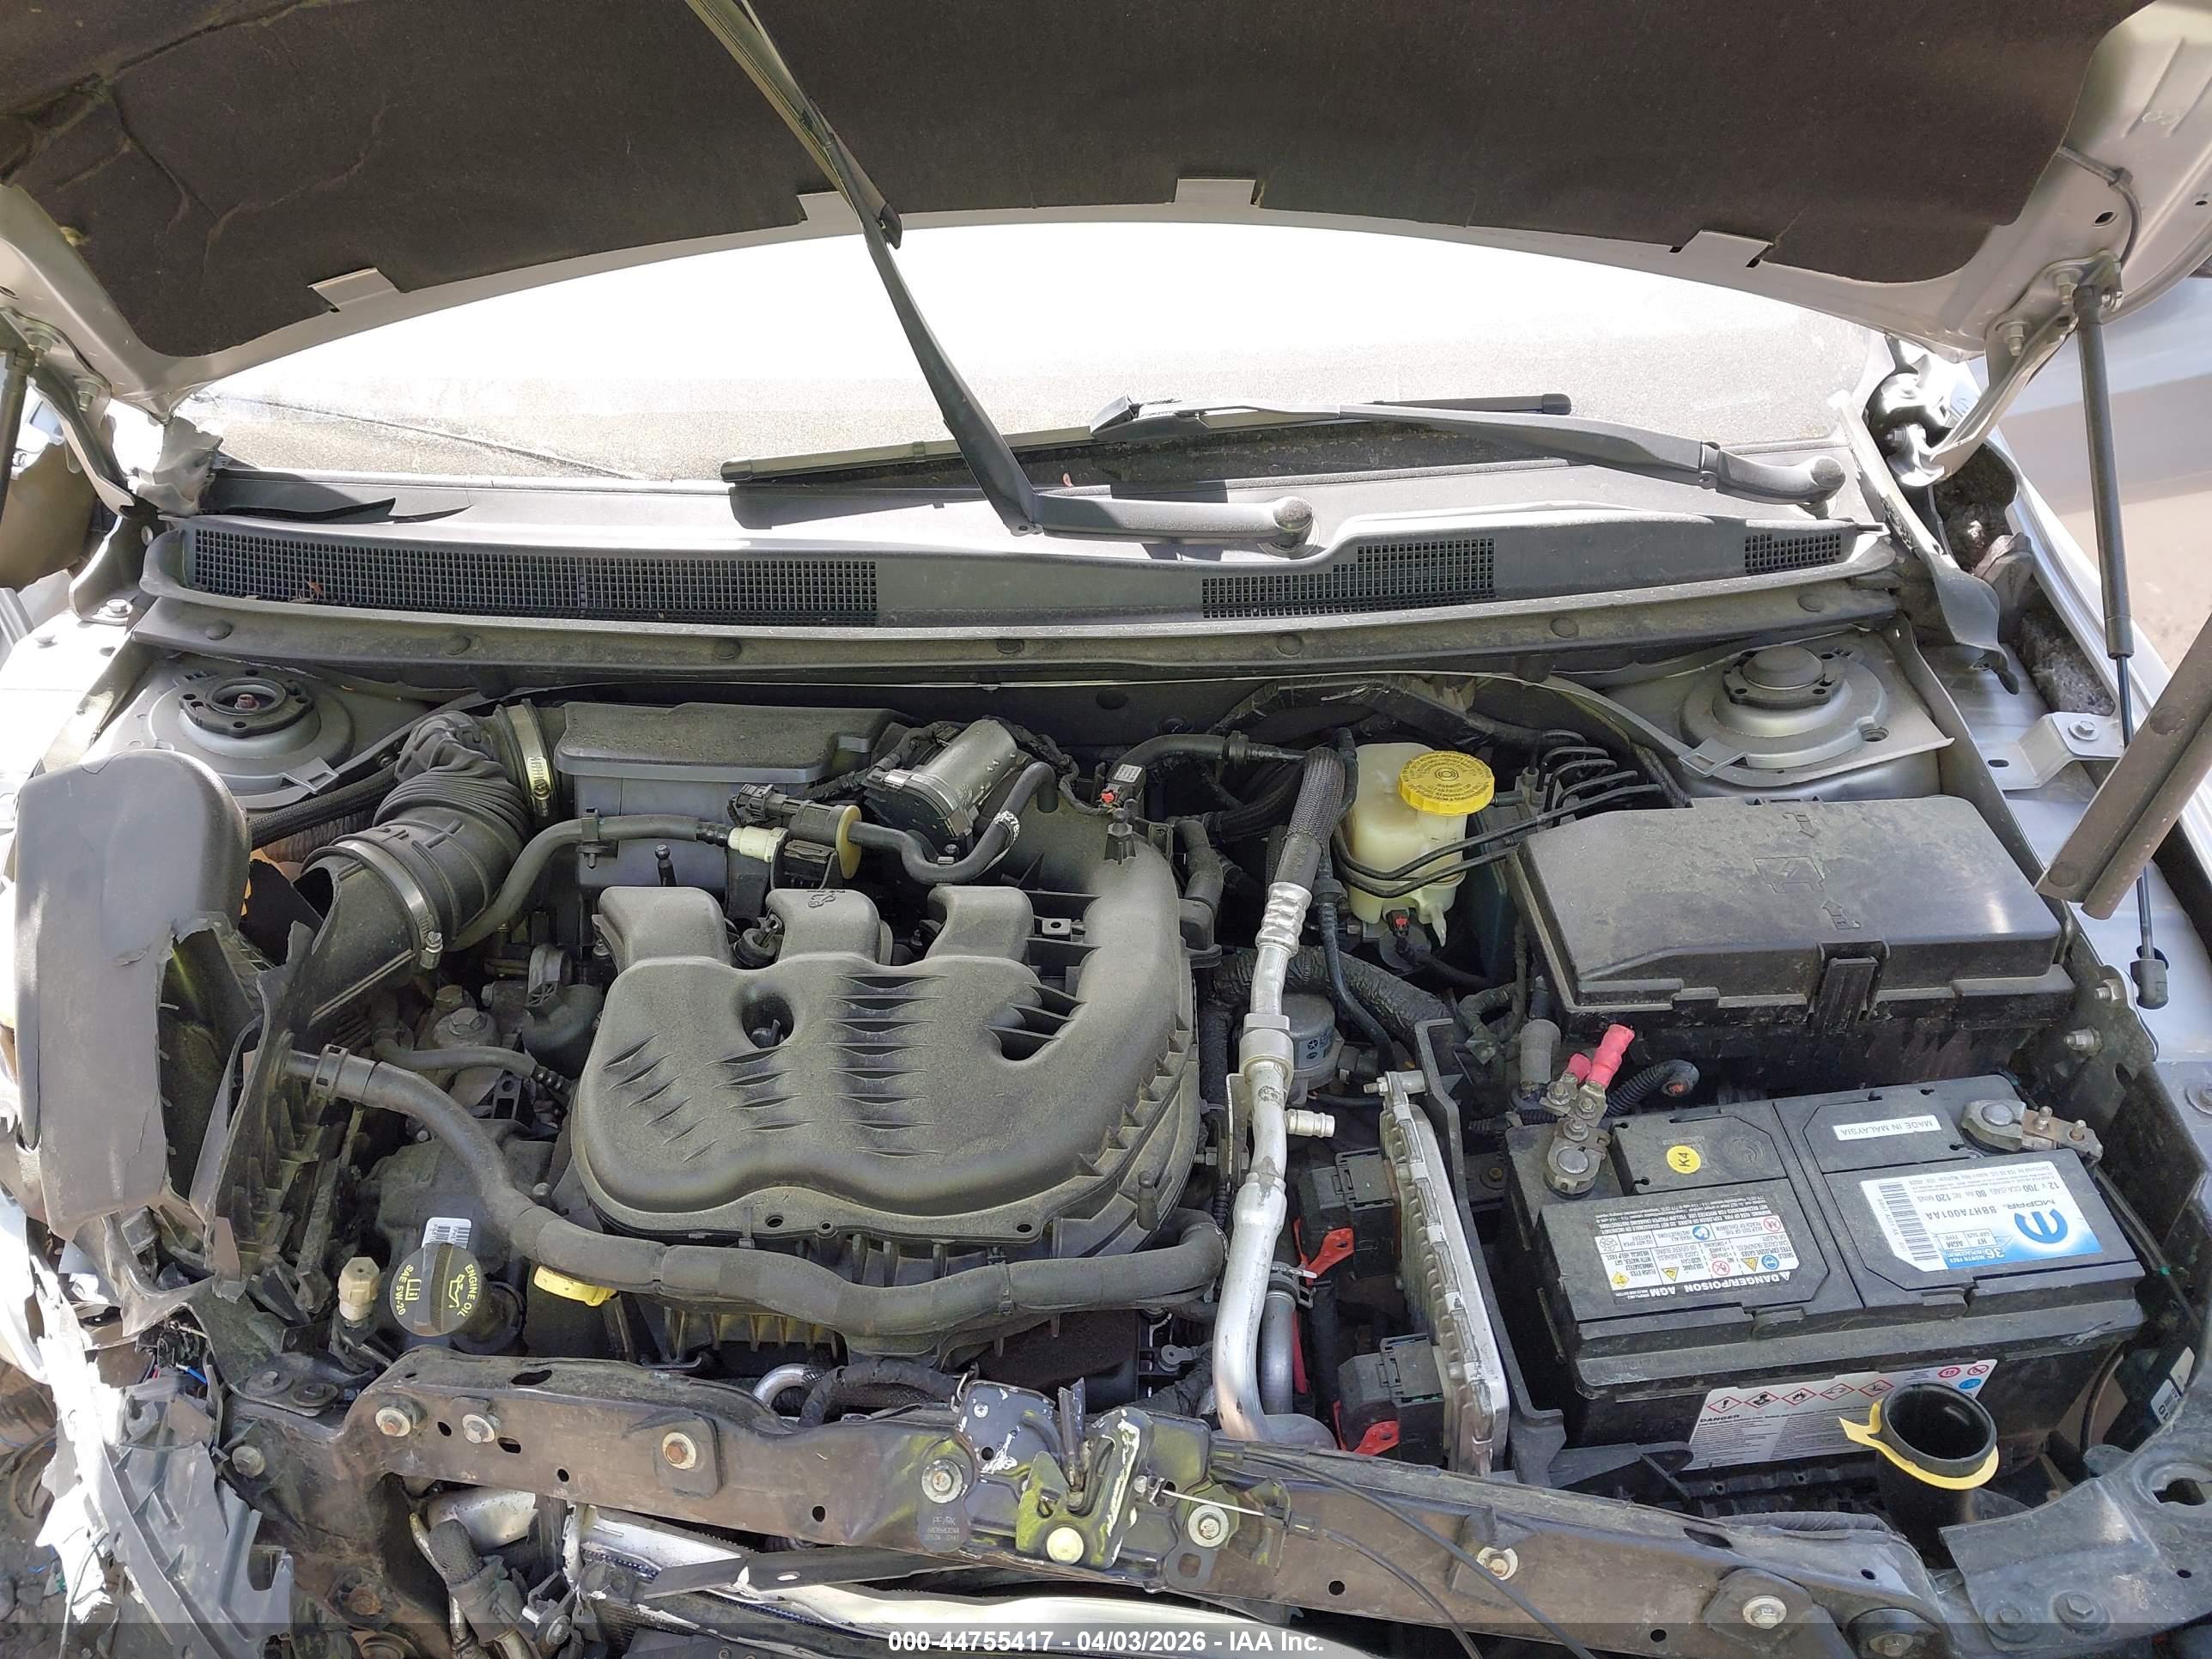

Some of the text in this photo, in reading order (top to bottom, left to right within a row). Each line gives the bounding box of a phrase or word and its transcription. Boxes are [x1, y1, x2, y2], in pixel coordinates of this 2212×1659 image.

[1840, 1124, 1890, 1136] MALAYSIA
[1903, 1120, 1934, 1129] MADE
[1677, 1152, 1691, 1168] K4
[2021, 1182, 2039, 1192] 700
[2046, 1181, 2059, 1189] 12
[1935, 1193, 1952, 1202] 120
[2005, 1198, 2056, 1209] MOPAR
[1983, 1246, 2004, 1259] 36
[1682, 1273, 1781, 1291] DANGER/POISON
[395, 1264, 415, 1316] SAE 5W-20
[457, 1264, 478, 1317] ENGINE OIL
[1648, 1285, 1678, 1296] AGM
[1699, 1414, 1741, 1423] DANGER
